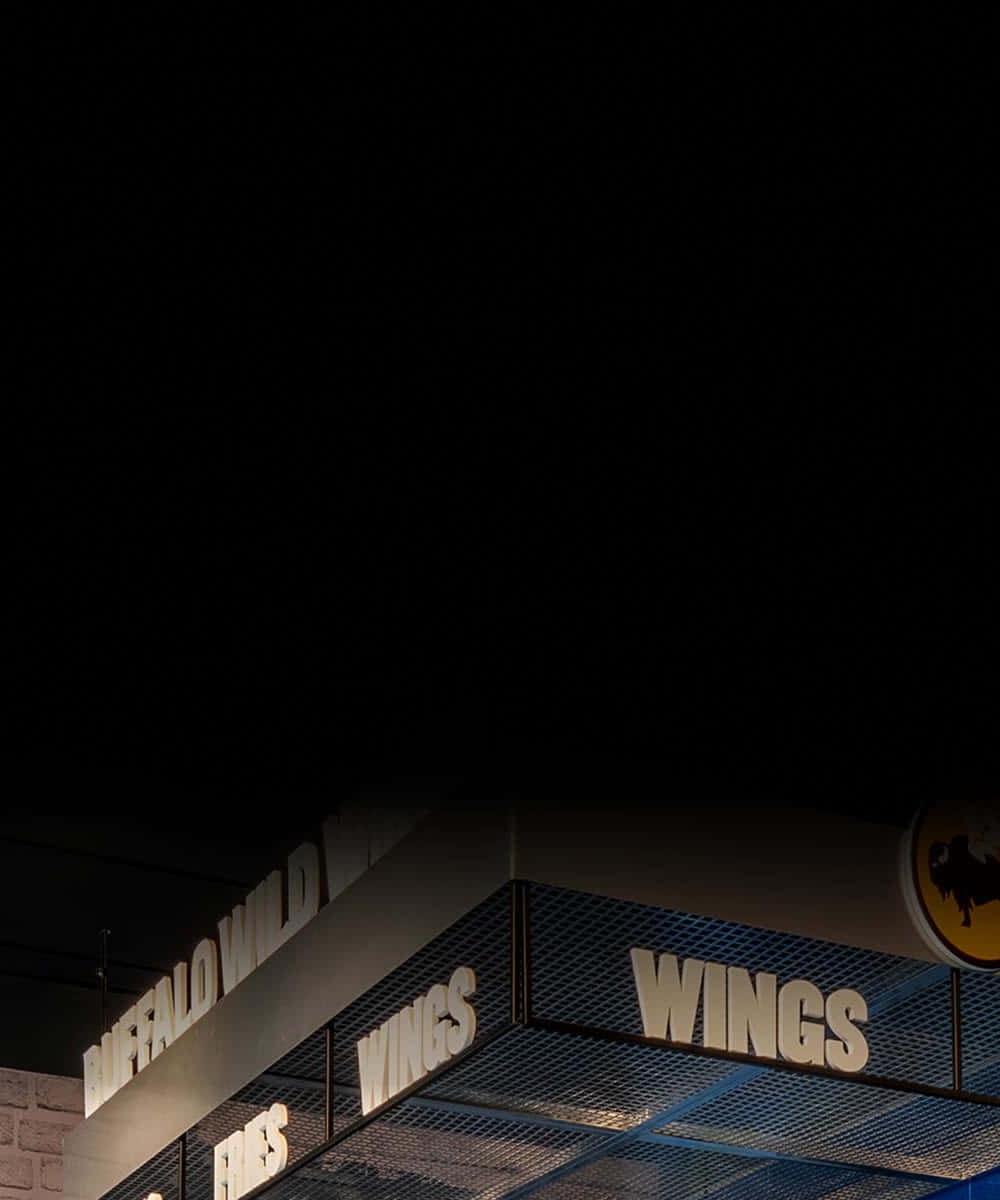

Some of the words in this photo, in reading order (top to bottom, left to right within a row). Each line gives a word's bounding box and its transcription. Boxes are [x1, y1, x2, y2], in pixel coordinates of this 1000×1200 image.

[83, 937, 218, 1120] BUFFALO
[217, 841, 321, 996] WILD
[357, 965, 478, 1117] WINGS
[630, 947, 870, 1073] WINGS
